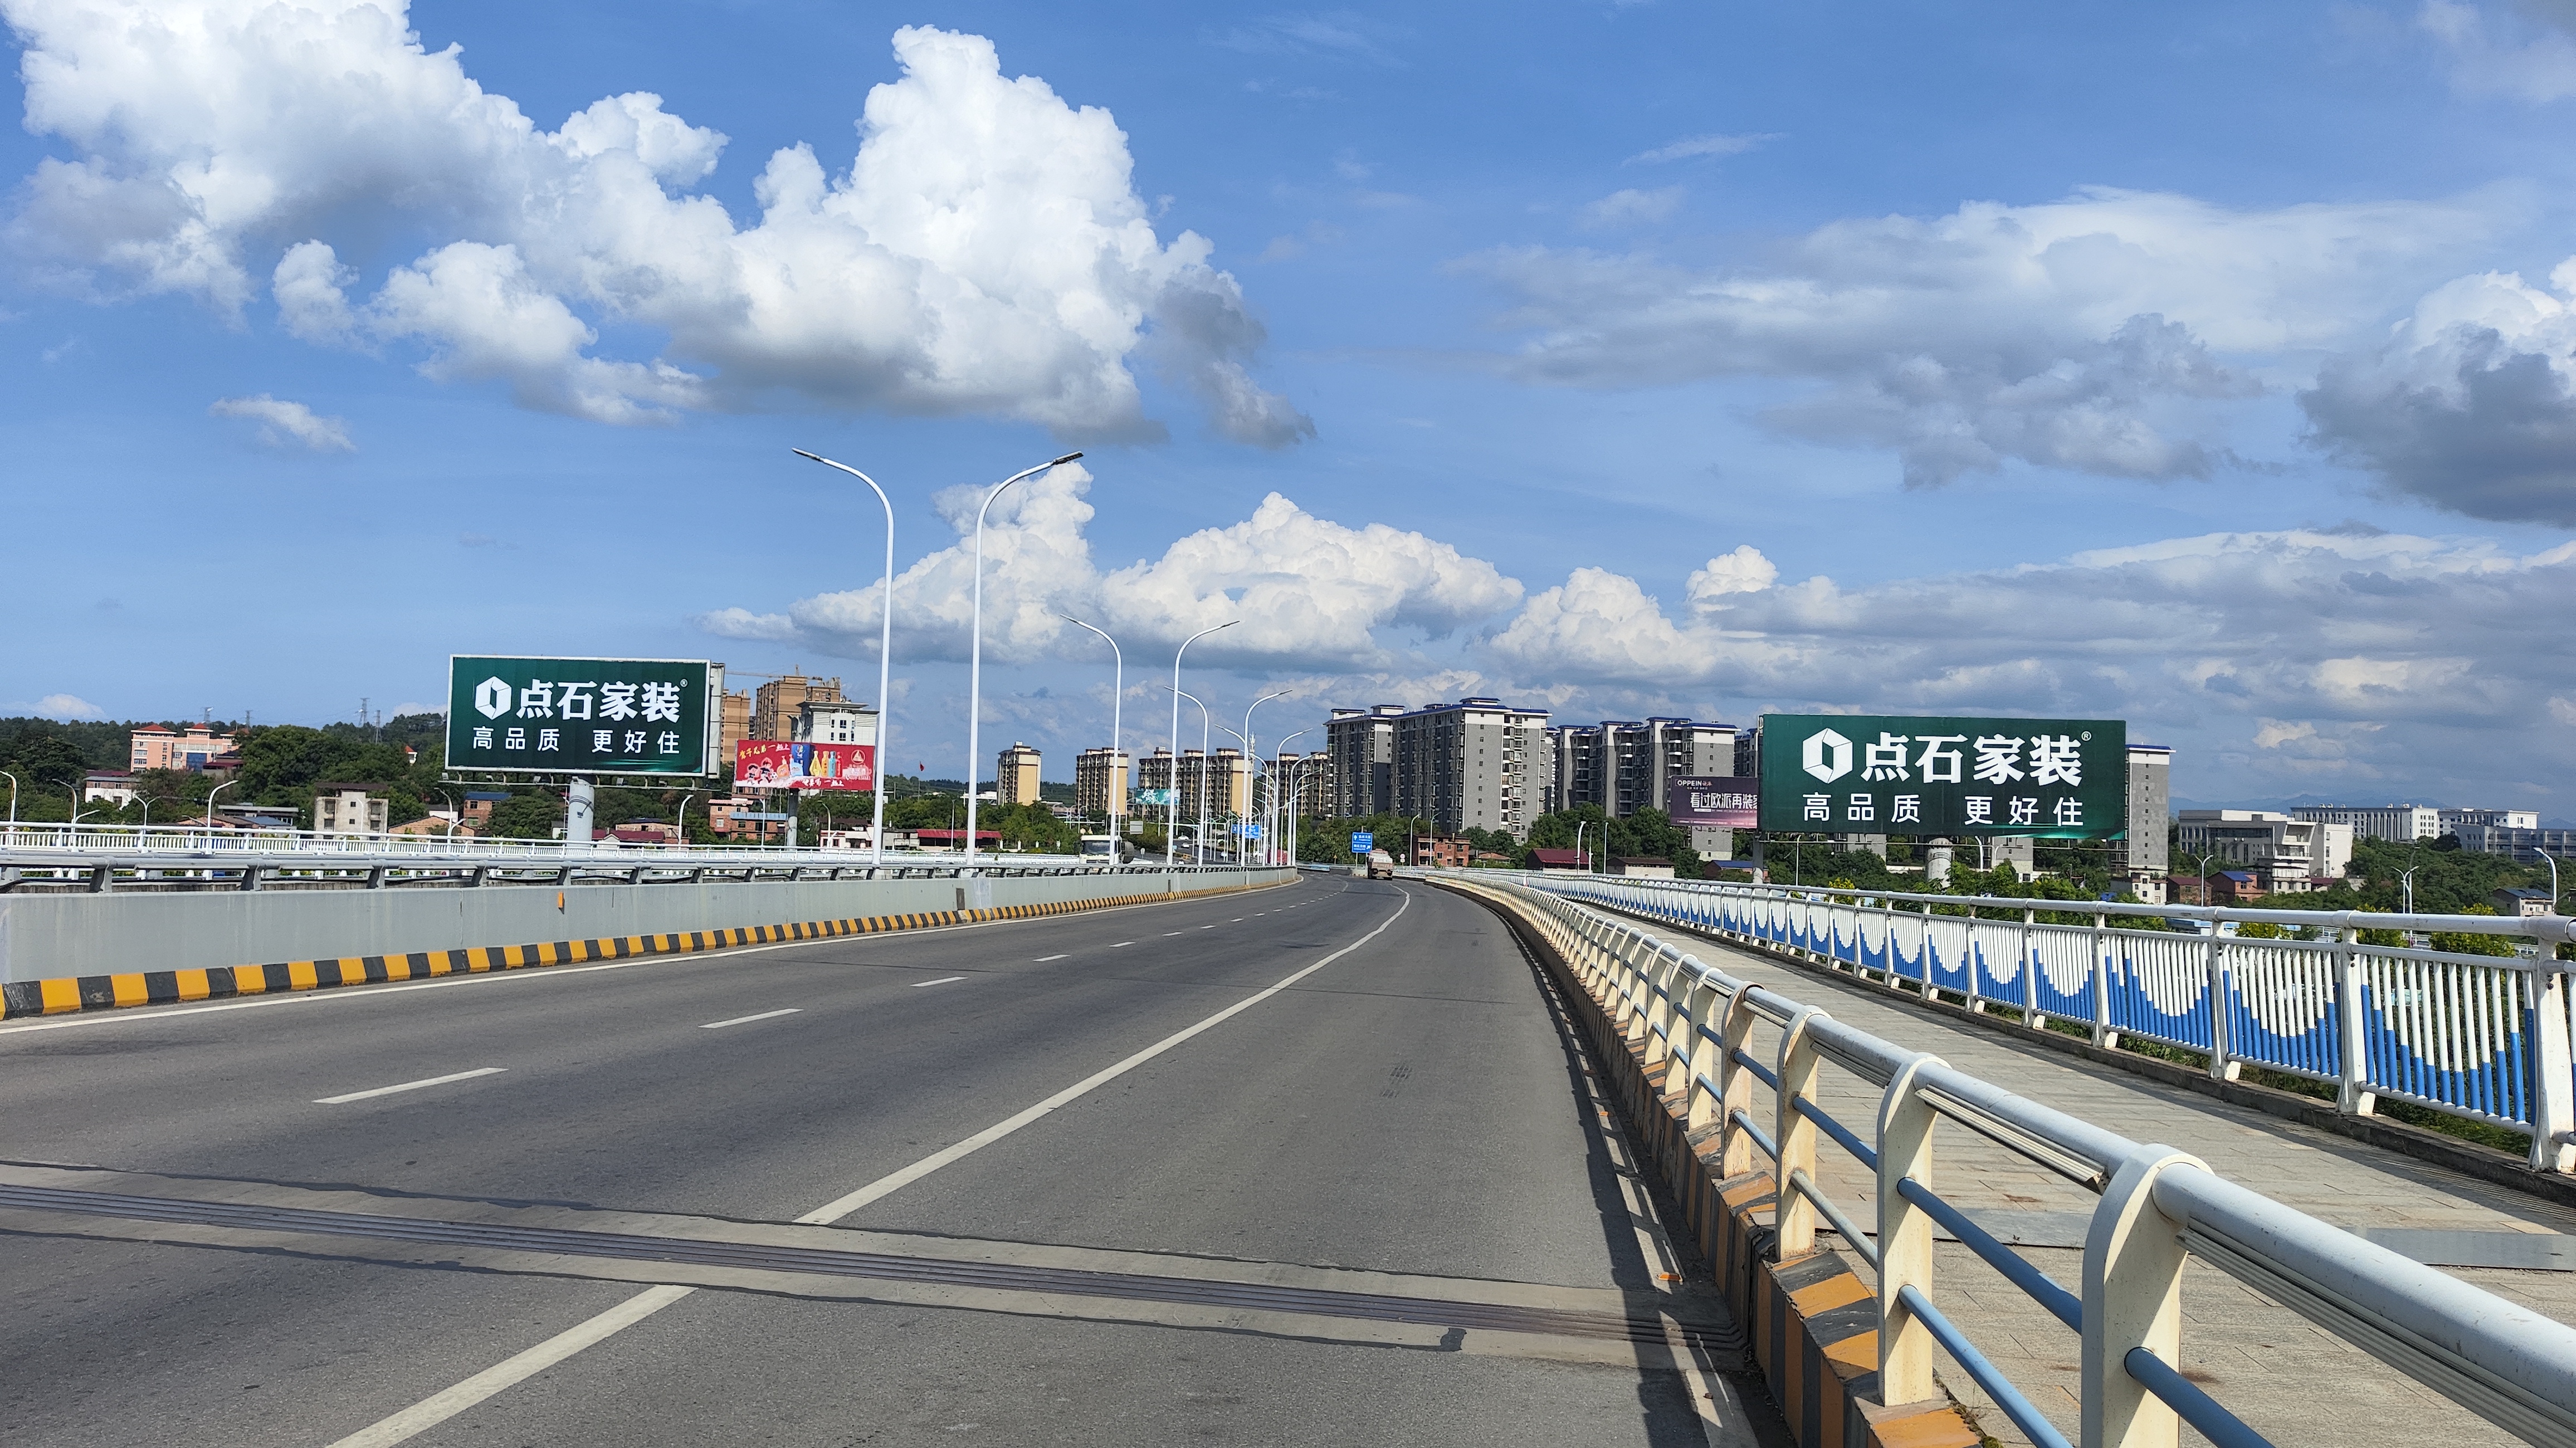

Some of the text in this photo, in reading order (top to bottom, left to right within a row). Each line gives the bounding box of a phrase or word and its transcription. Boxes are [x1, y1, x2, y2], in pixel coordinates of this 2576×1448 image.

[516, 678, 680, 723] 点石家装
[473, 726, 680, 754] 高品质 更好住
[1860, 732, 2082, 787] 点石家装
[1802, 792, 2084, 826] 高品质 更好住
